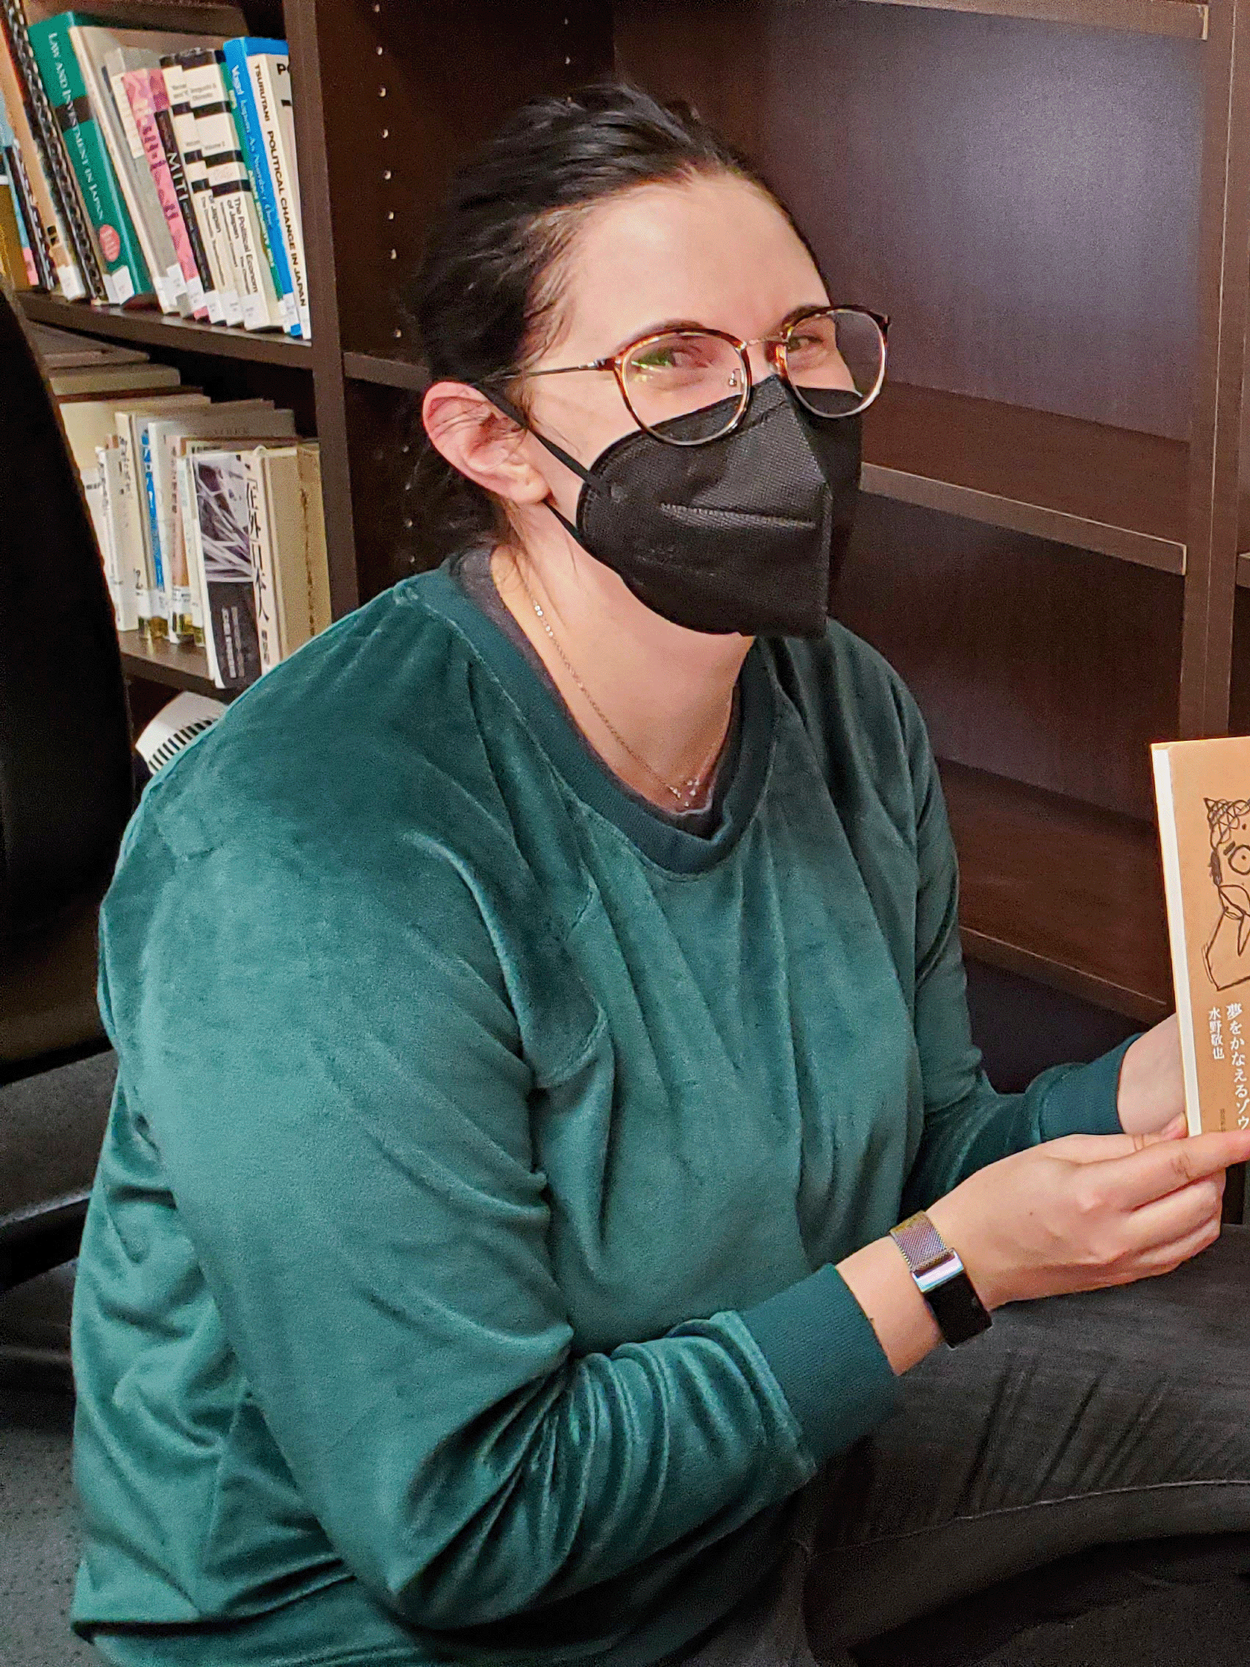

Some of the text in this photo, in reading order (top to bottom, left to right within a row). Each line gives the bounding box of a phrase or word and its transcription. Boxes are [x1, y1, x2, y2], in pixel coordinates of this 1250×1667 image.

[254, 64, 270, 122] TSURUTANI
[167, 151, 189, 202] MITI
[267, 130, 308, 307] POLITICAL CHANGE IN JAPAN
[1208, 1006, 1225, 1060] 水野敬也
[1226, 1002, 1250, 1130] 夢をかなえるゾウ
